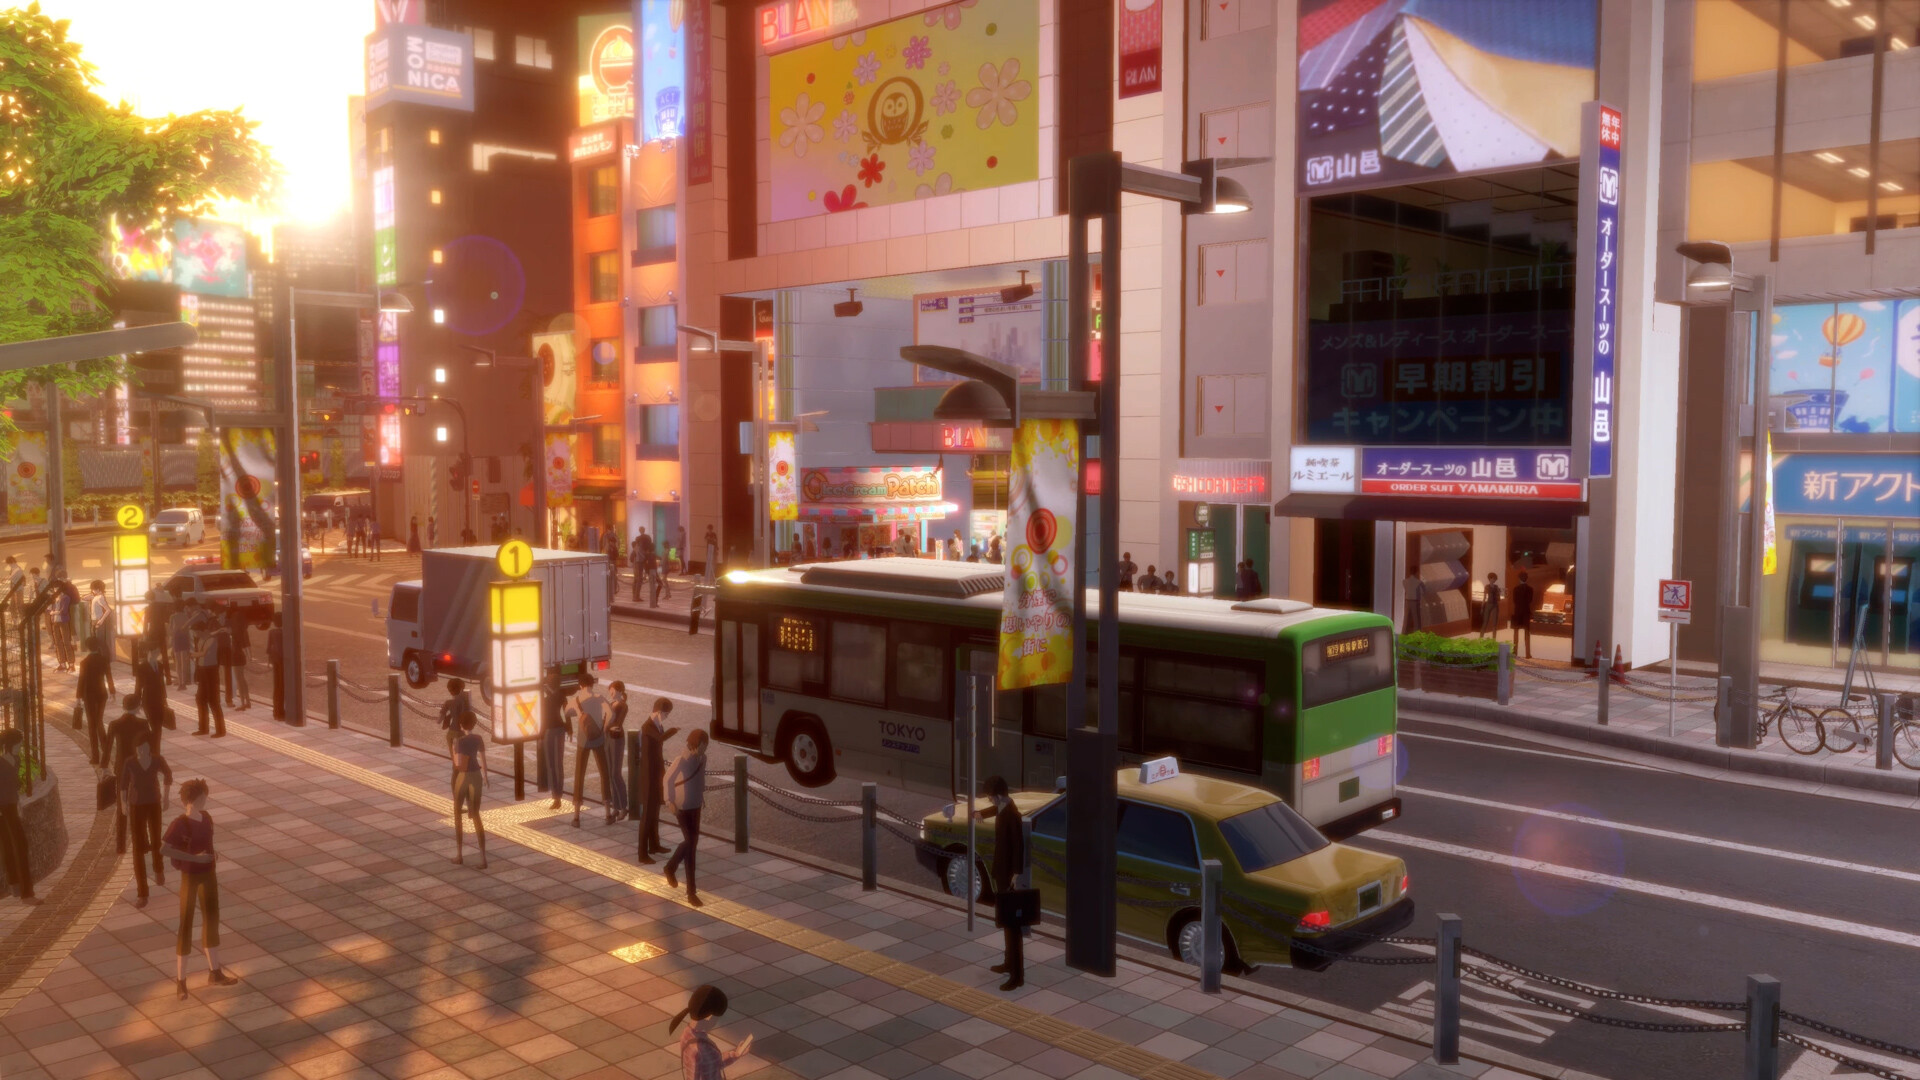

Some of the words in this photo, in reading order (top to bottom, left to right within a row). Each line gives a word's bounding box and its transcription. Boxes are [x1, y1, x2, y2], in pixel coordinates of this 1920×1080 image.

[1336, 150, 1380, 179] 山邑
[1598, 217, 1613, 355] オーダースーツの
[1462, 324, 1571, 344] オーダースー
[1395, 358, 1545, 394] 早期割引
[1594, 371, 1611, 442] 山邑
[1332, 402, 1564, 434] キャンペーン中
[1292, 470, 1354, 481] ルミエール
[1376, 462, 1467, 477] オーダースーツの
[1471, 457, 1517, 479] 山邑
[887, 474, 939, 497] Patch
[1390, 483, 1428, 492] ORDER
[1430, 484, 1454, 493] SUIT
[1457, 483, 1539, 495] YAMAMURA
[123, 507, 138, 526] 2
[508, 546, 519, 574] 1
[1002, 612, 1072, 634] 思いやりの
[1022, 638, 1048, 657] 街に
[878, 720, 926, 741] TOKYO
